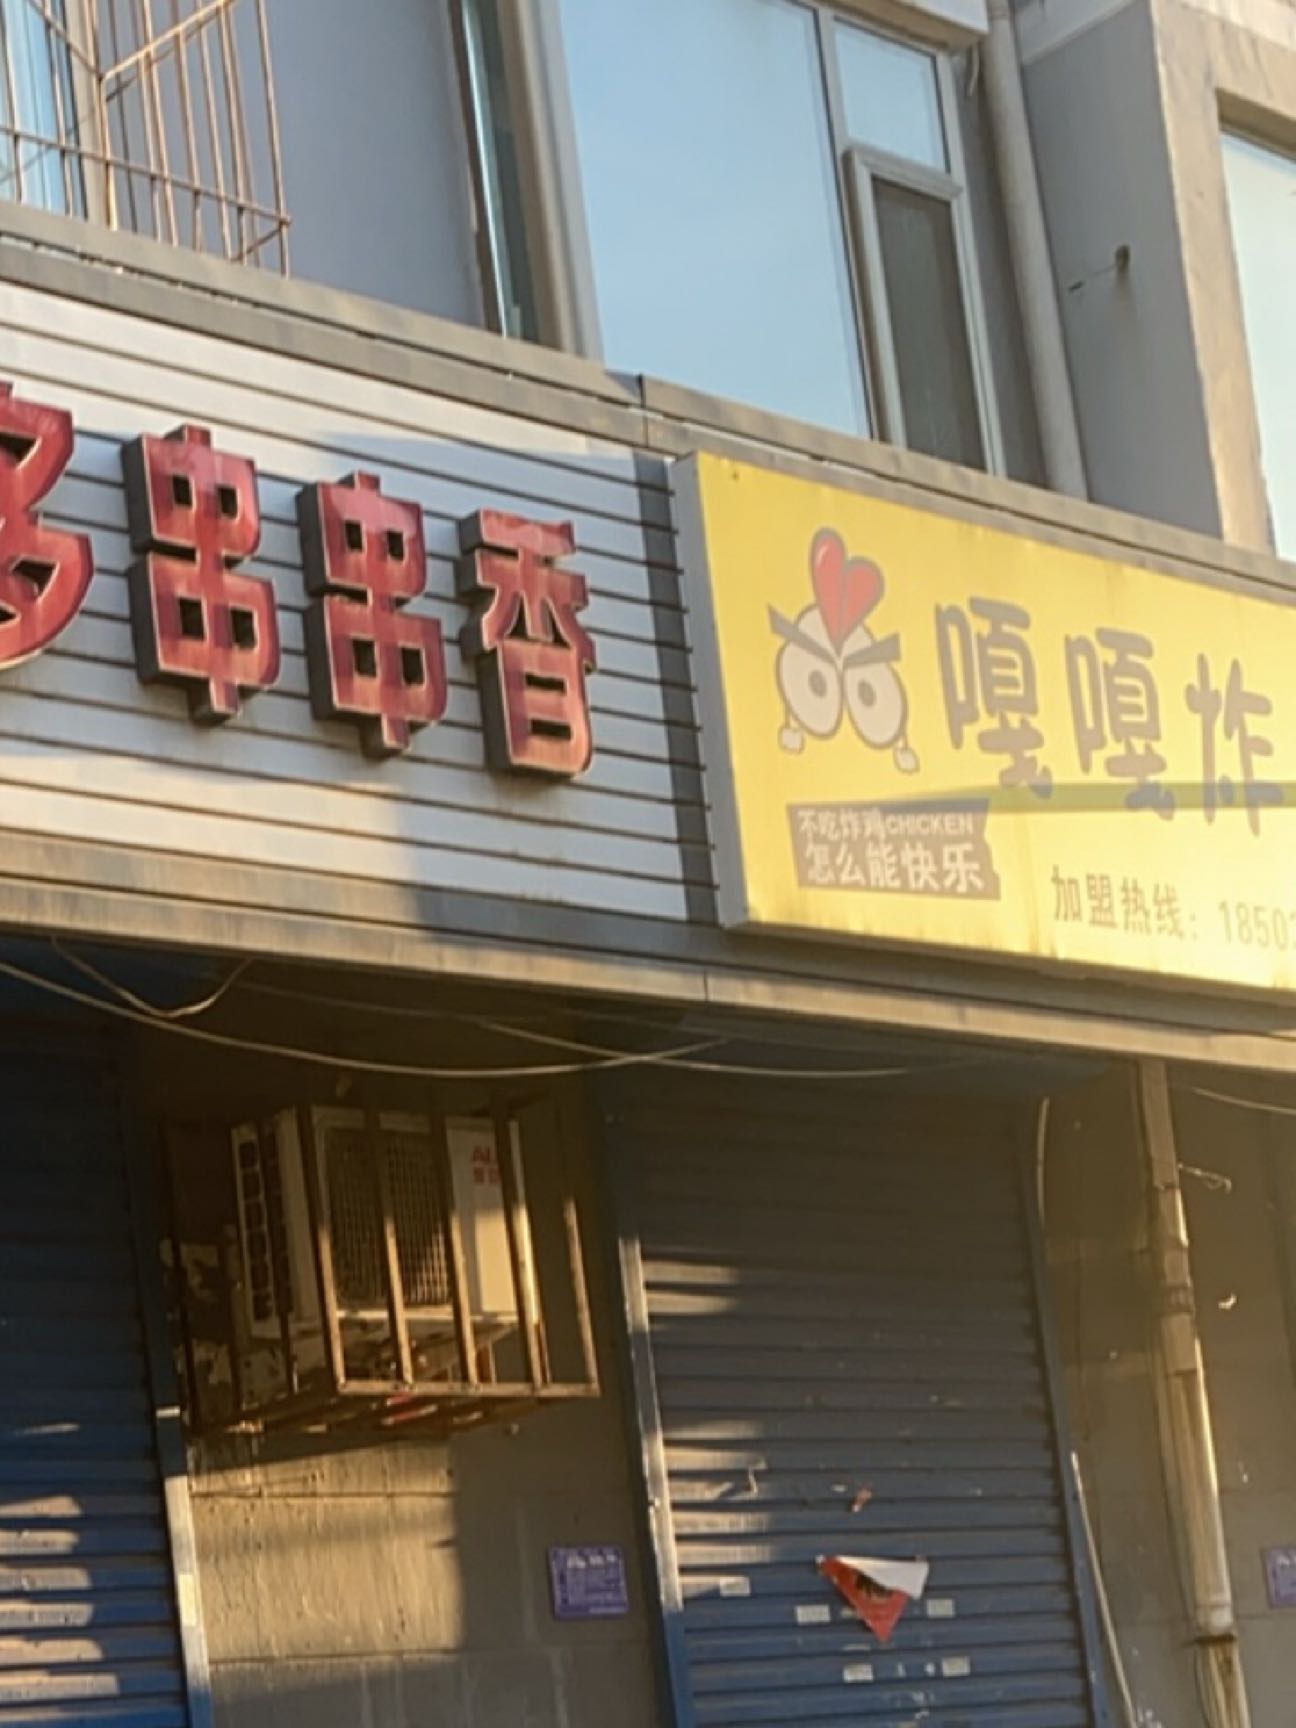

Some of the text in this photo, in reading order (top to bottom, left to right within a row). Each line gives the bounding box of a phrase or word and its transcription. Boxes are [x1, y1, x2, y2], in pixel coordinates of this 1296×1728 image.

[804, 840, 985, 894] 怎么能快乐
